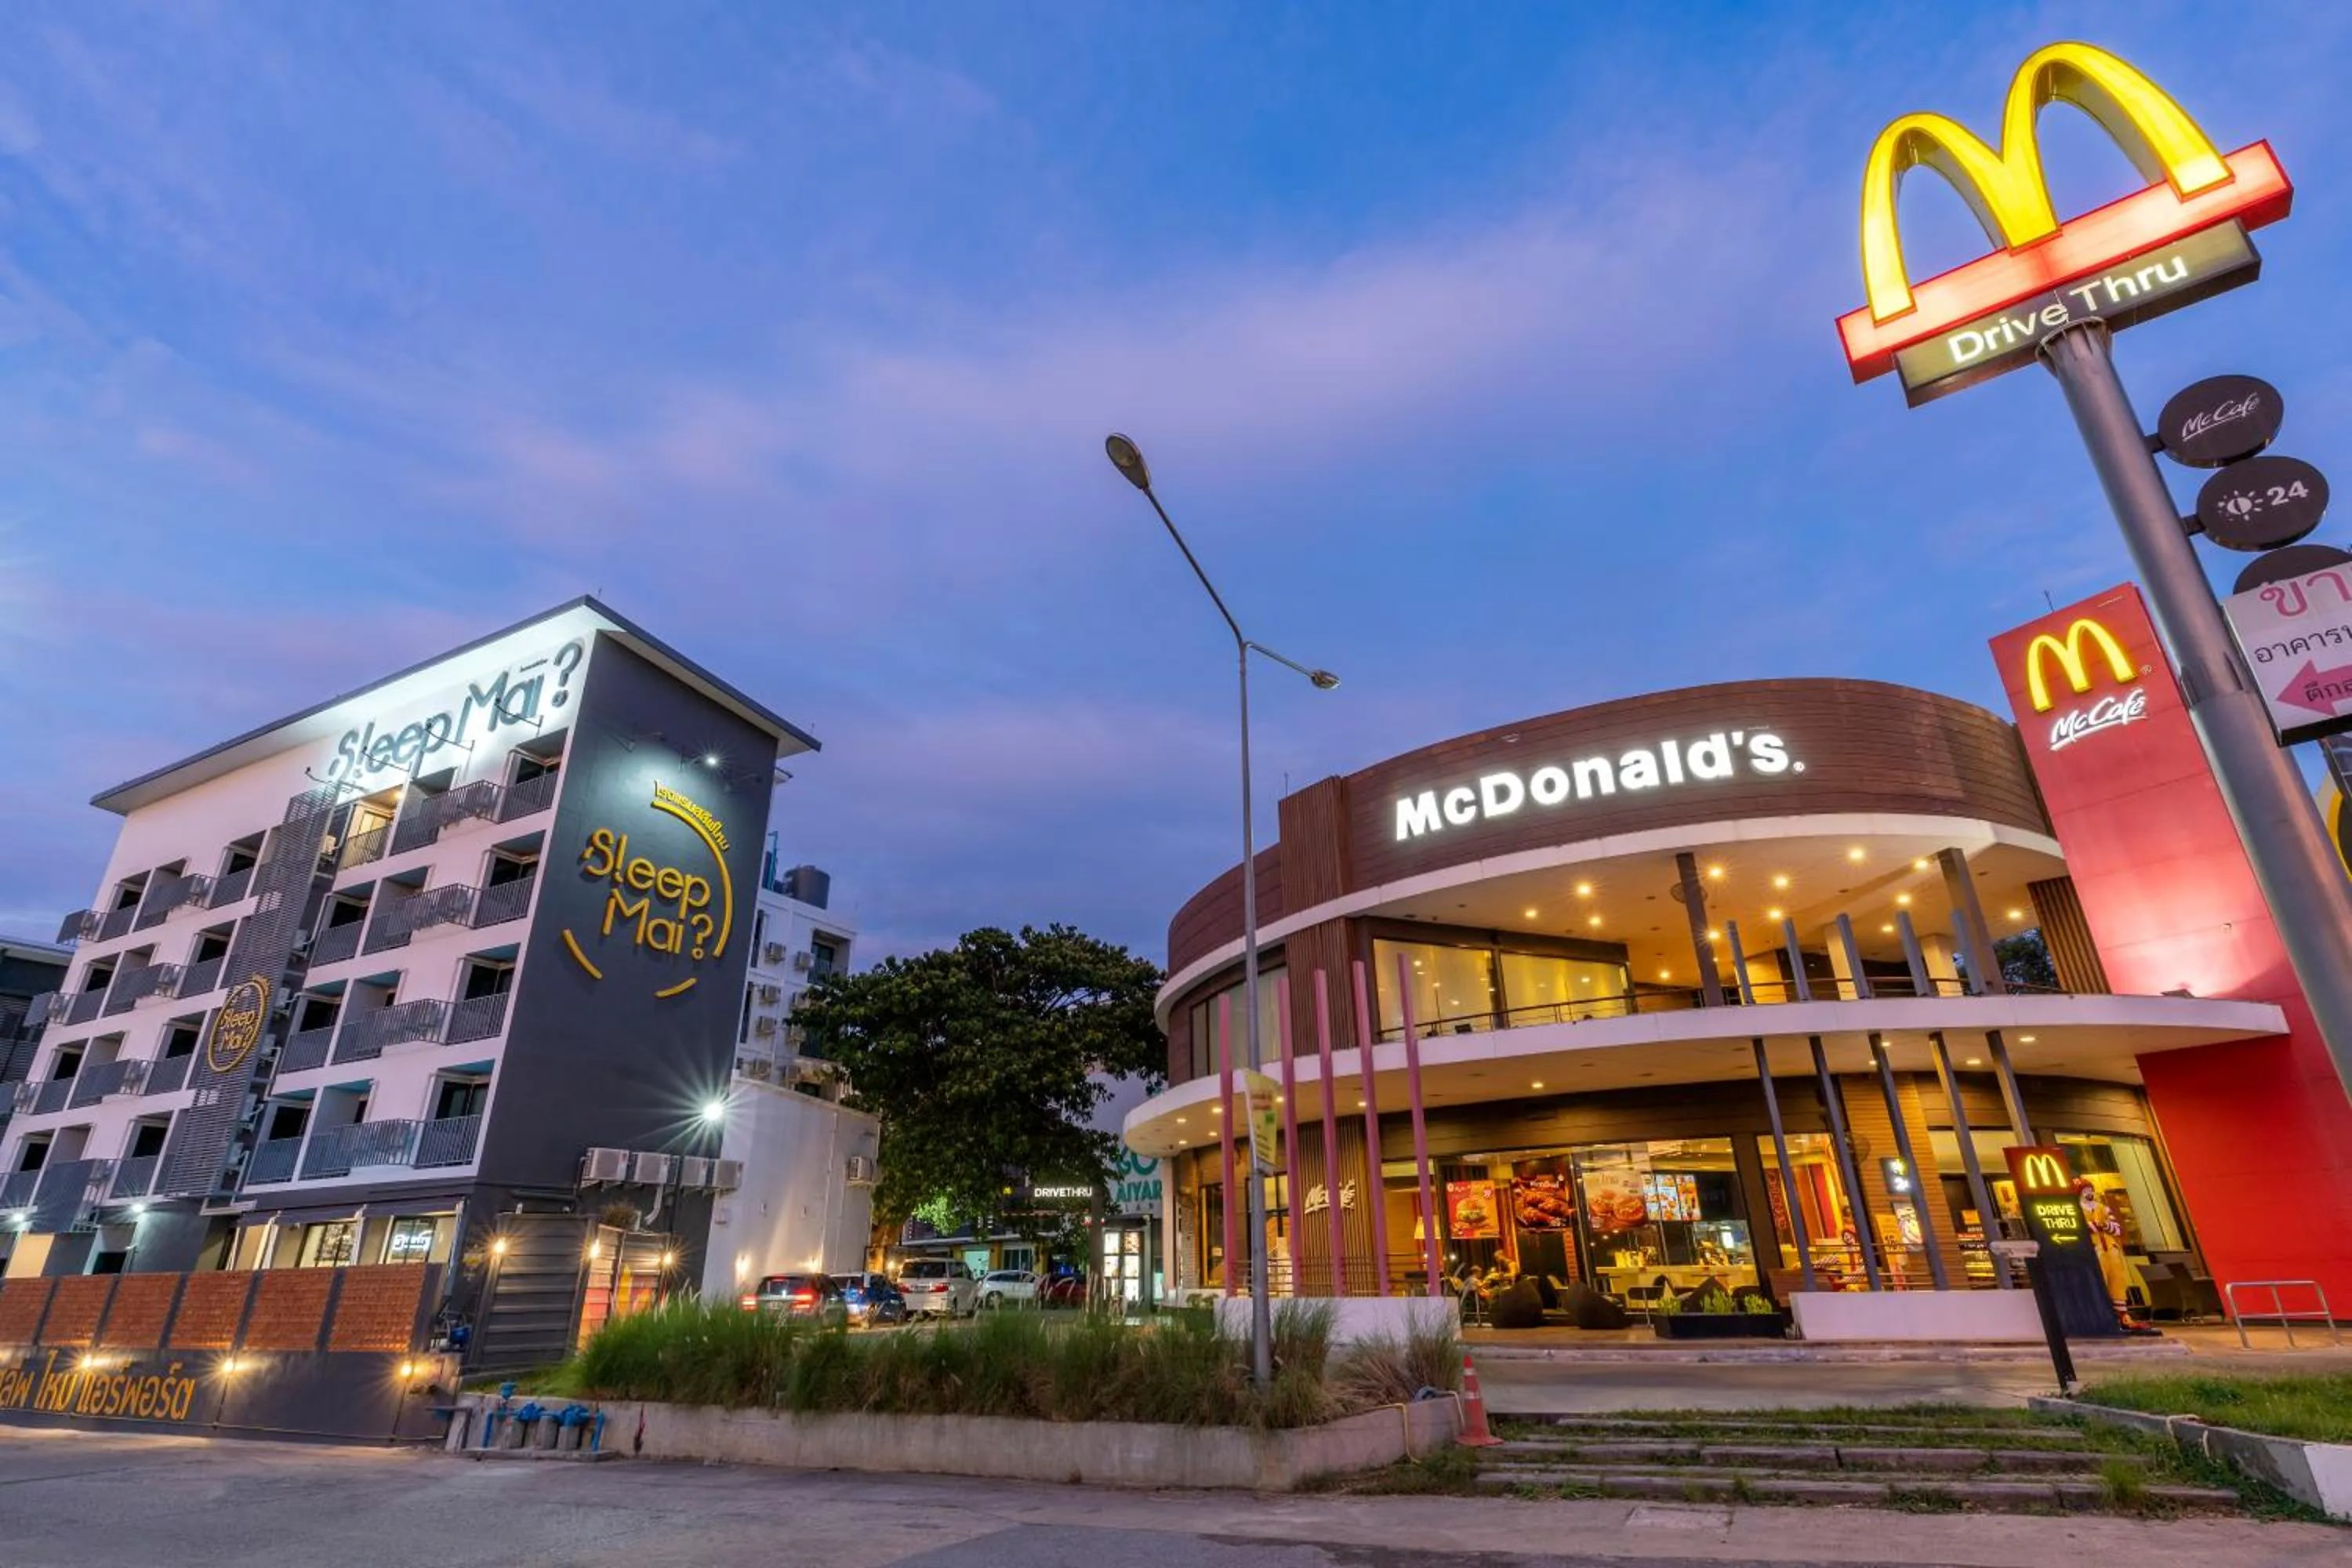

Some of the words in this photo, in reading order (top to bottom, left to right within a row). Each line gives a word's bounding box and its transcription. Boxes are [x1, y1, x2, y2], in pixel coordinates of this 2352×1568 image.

[1947, 301, 2071, 365] Drive
[2068, 255, 2190, 313] Thru
[2267, 480, 2309, 506] 24
[2259, 560, 2352, 618] ขา
[1396, 731, 1790, 841] McDonald's
[583, 827, 712, 920] Sleep
[2036, 1204, 2076, 1216] DRIVE
[2042, 1218, 2078, 1229] THRU
